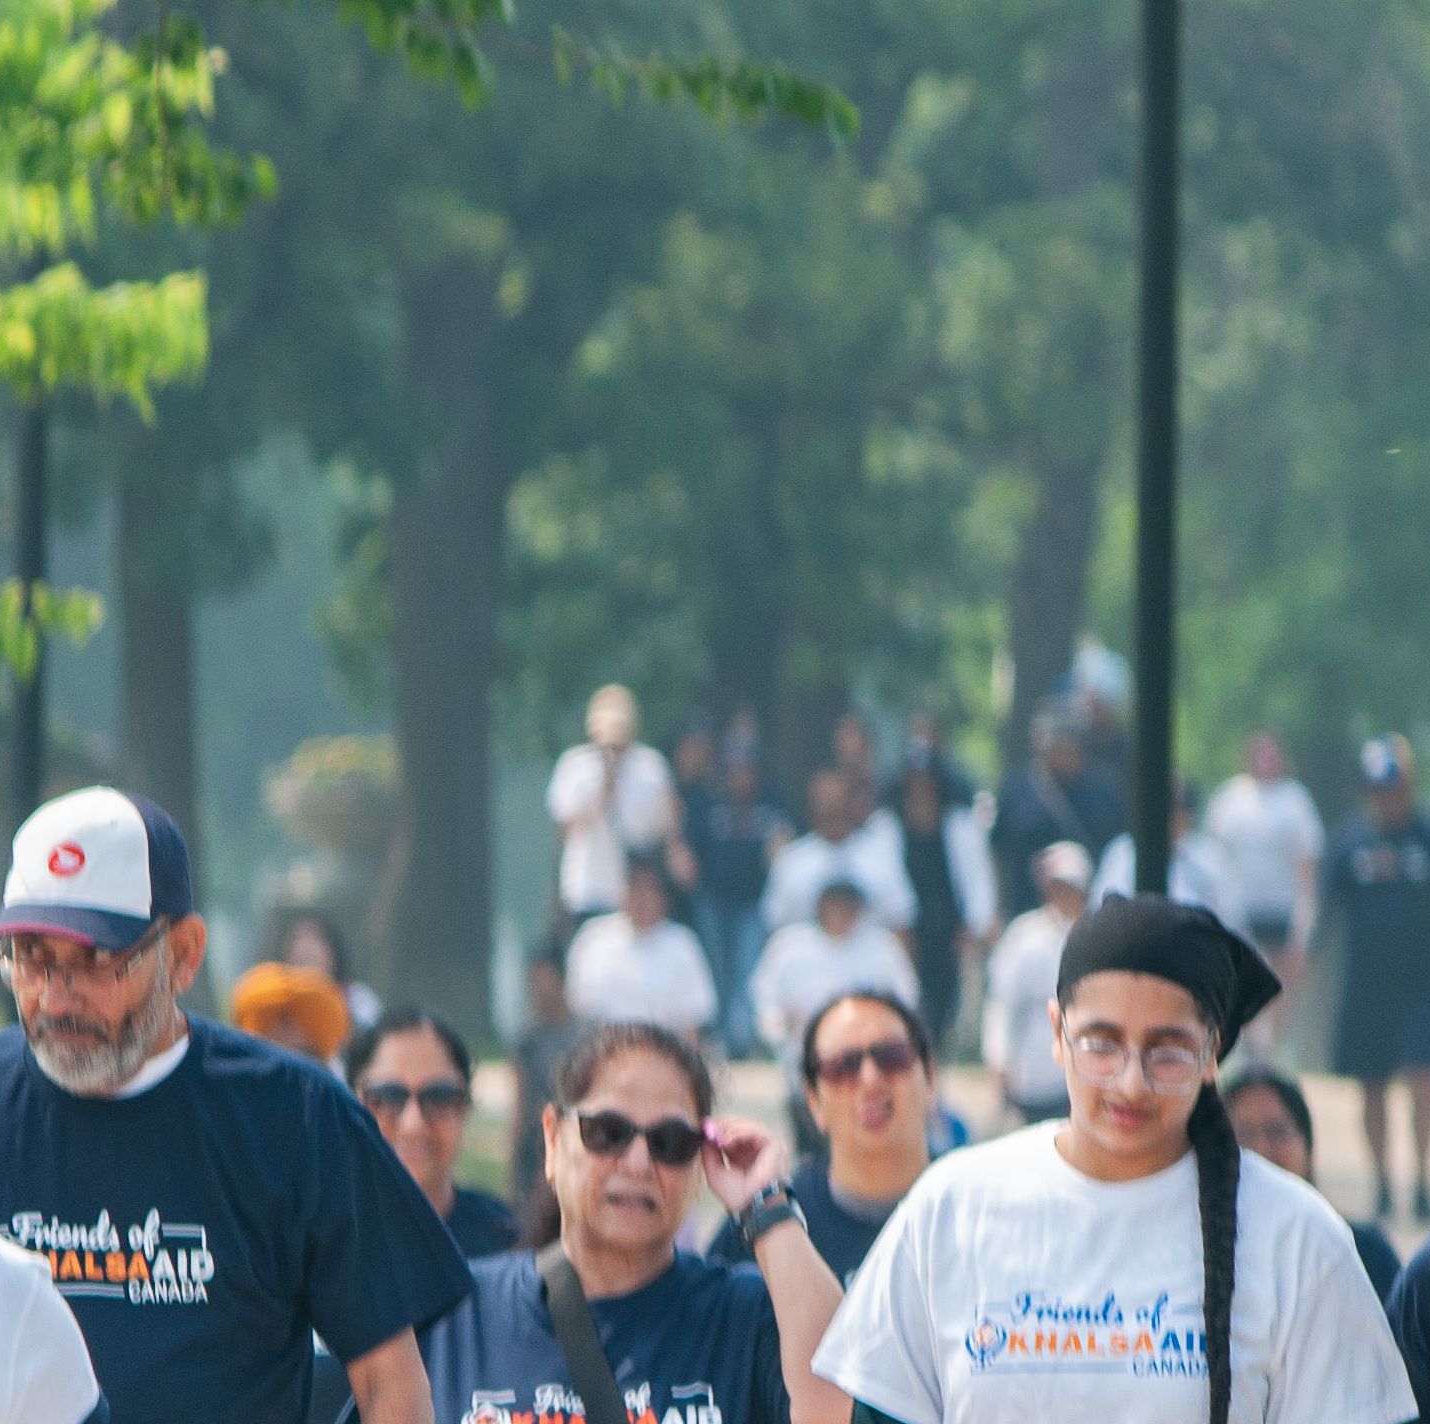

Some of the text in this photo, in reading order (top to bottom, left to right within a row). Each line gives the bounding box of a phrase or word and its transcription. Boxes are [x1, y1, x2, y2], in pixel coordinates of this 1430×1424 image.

[12, 1207, 161, 1262] Friends of
[128, 1278, 209, 1304] CANADA
[1011, 1290, 1168, 1332] Friends of
[624, 1381, 651, 1417] of
